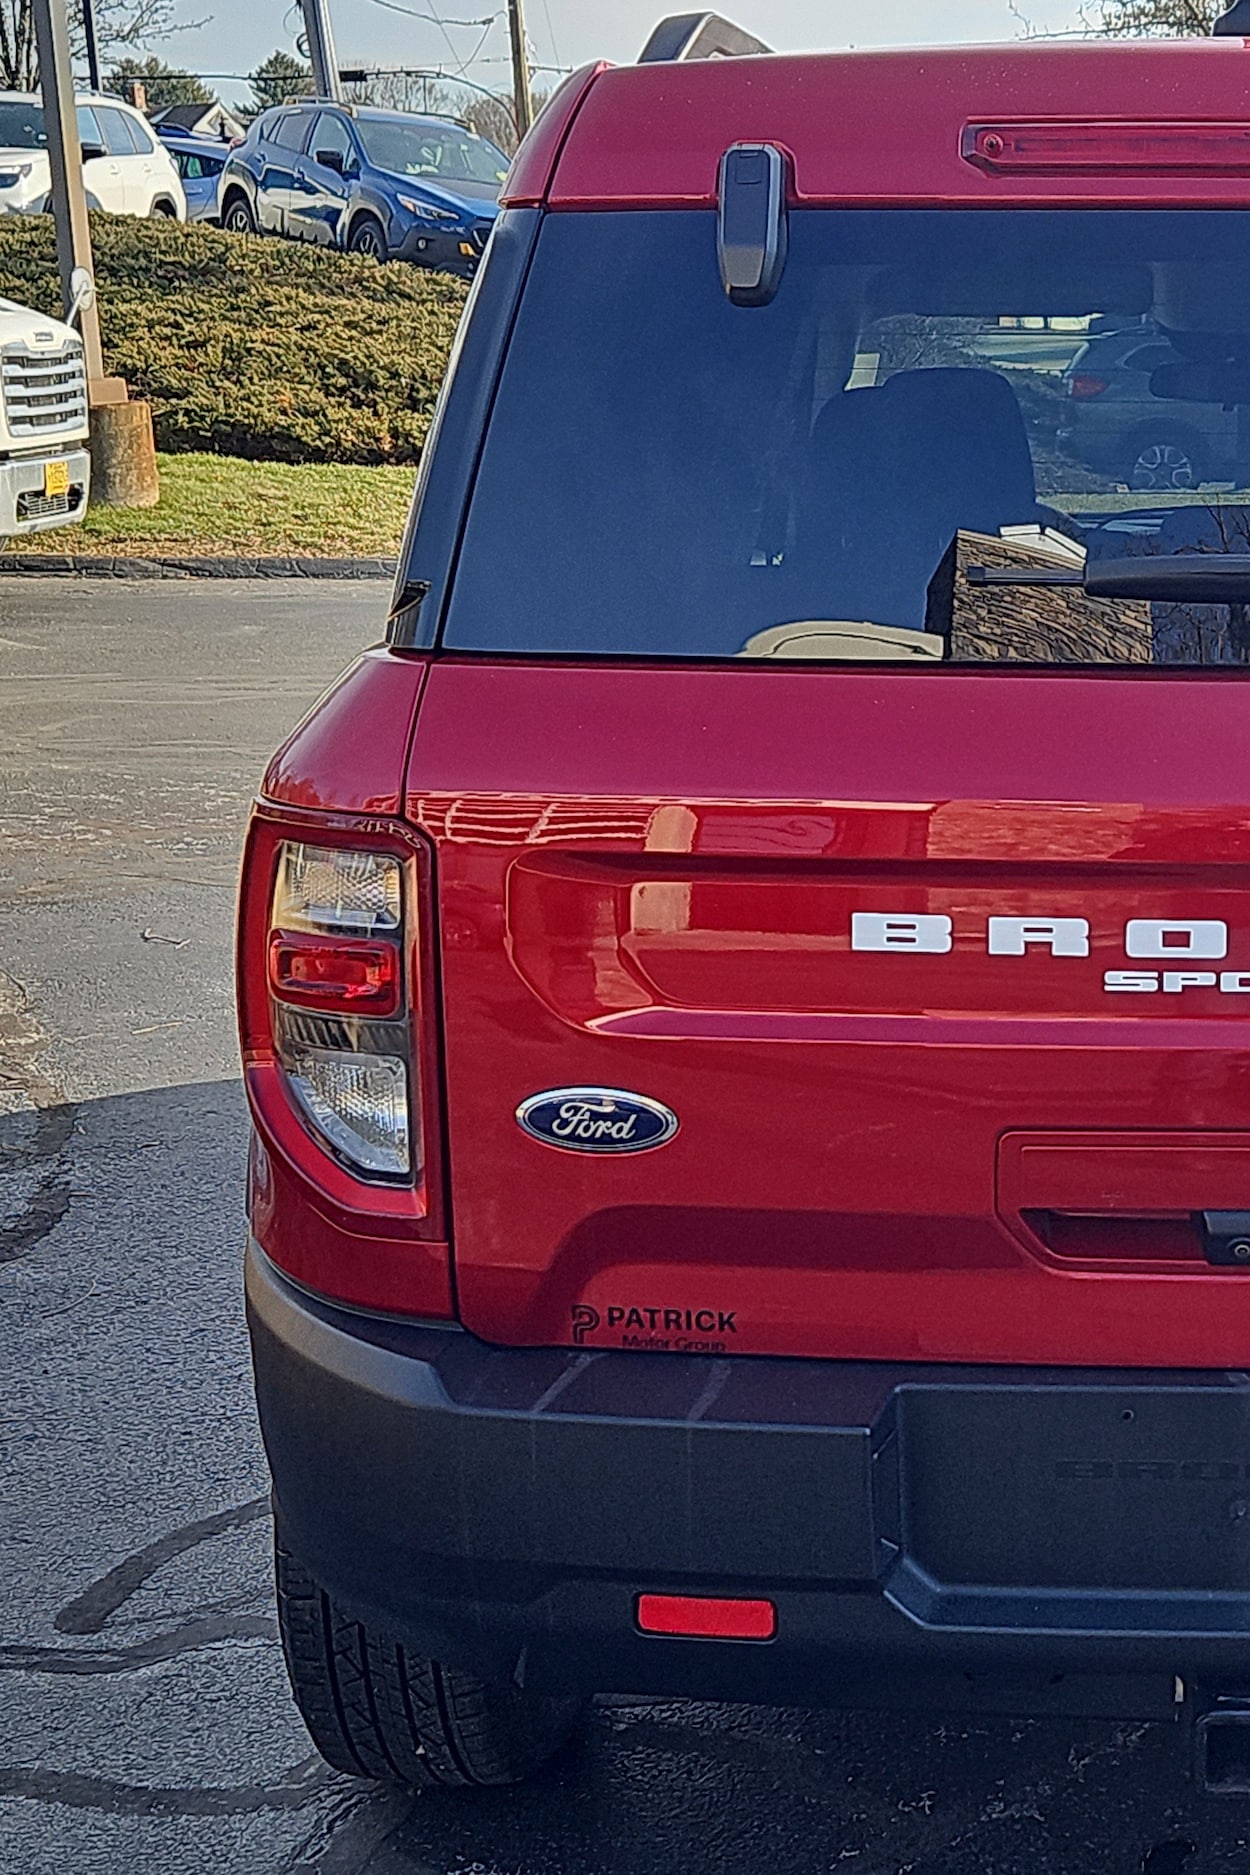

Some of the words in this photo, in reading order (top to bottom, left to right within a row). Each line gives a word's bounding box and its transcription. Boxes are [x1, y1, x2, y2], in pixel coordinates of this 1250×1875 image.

[552, 1101, 637, 1140] Ford
[607, 1306, 737, 1333] PATRICK
[622, 1334, 671, 1349] Motor
